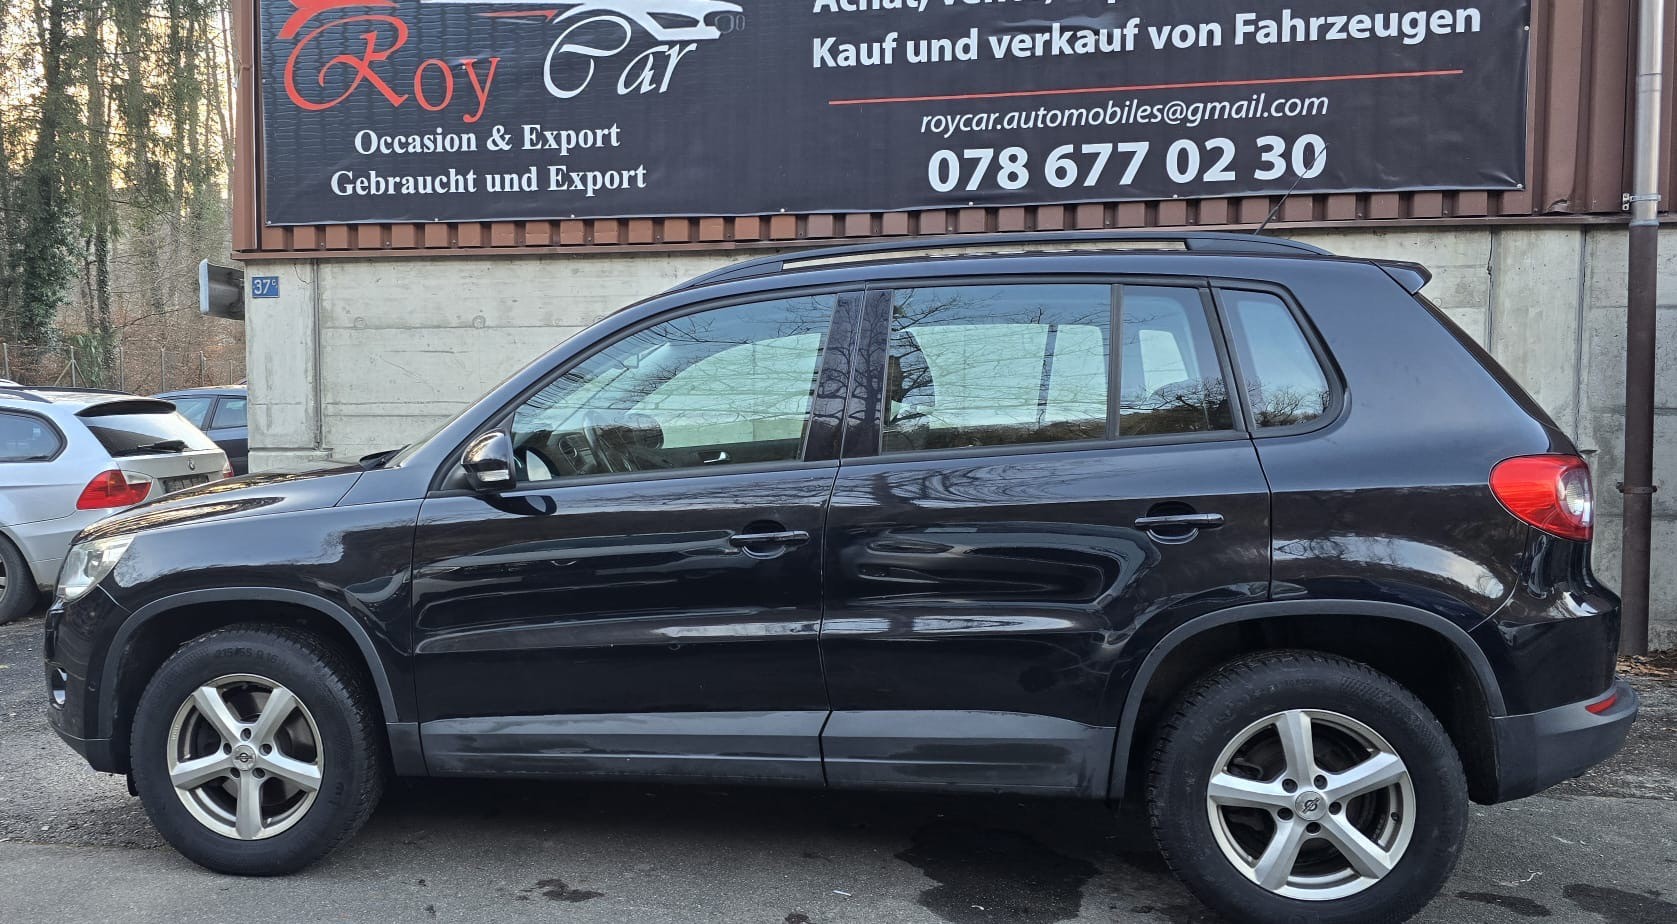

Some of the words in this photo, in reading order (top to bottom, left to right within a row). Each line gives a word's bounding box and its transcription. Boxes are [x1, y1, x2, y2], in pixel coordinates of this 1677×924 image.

[813, 32, 899, 68] Kauf
[906, 28, 979, 63] und
[988, 17, 1140, 59] verkauf
[1148, 23, 1222, 50] von
[1235, 7, 1481, 46] Fahrzeugen
[284, 15, 501, 123] Roy
[543, 15, 698, 99] Car
[354, 128, 478, 155] Occasion
[486, 125, 513, 151] &
[522, 122, 621, 156] Export
[920, 93, 1329, 137] roycar.automobiles@gmail.com
[331, 168, 477, 196] Gebraucht
[485, 167, 539, 193] und
[547, 164, 647, 197] Export
[928, 146, 1030, 193] 078
[1044, 141, 1150, 188] 677
[1166, 138, 1236, 184] 02
[1254, 133, 1327, 180] 30
